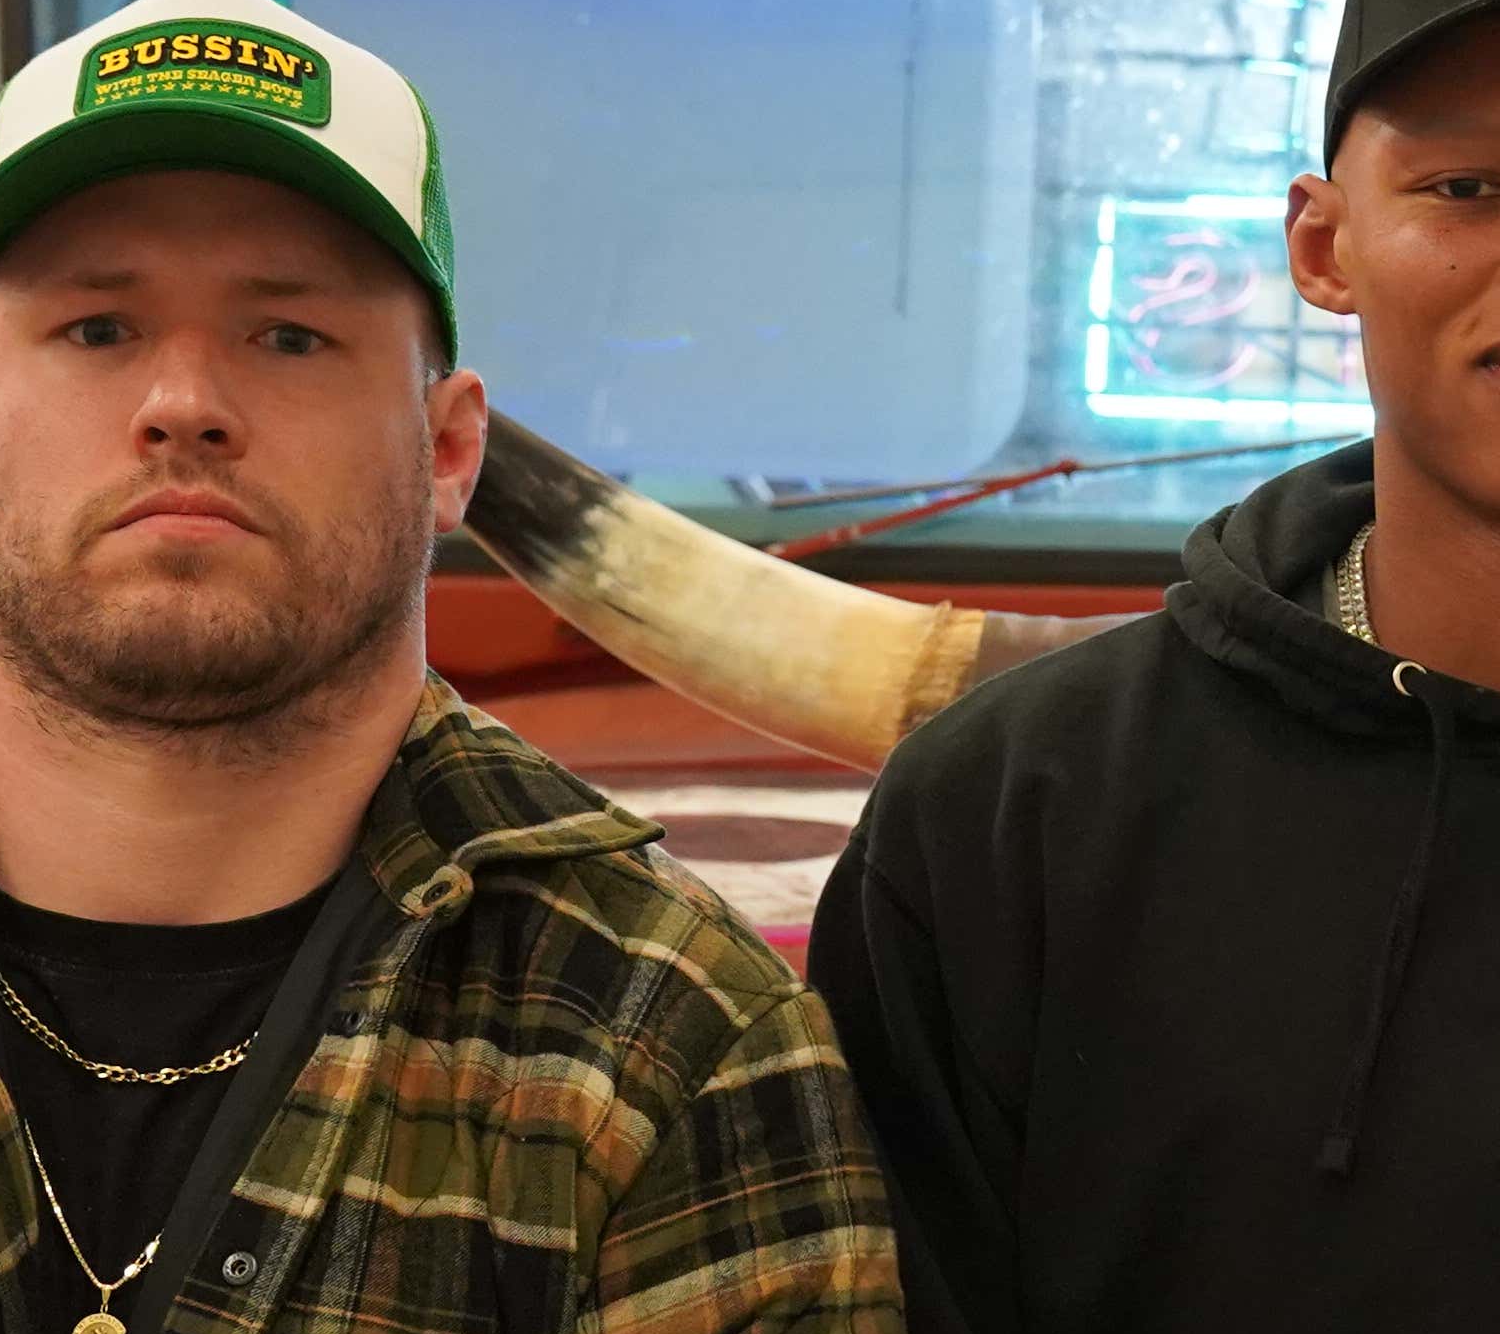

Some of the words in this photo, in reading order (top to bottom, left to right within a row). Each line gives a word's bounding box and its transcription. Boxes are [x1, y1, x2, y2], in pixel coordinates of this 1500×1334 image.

[97, 33, 314, 81] BUSSIN'
[95, 75, 143, 96] WITH
[146, 69, 183, 83] THE
[259, 79, 303, 101] BOYS
